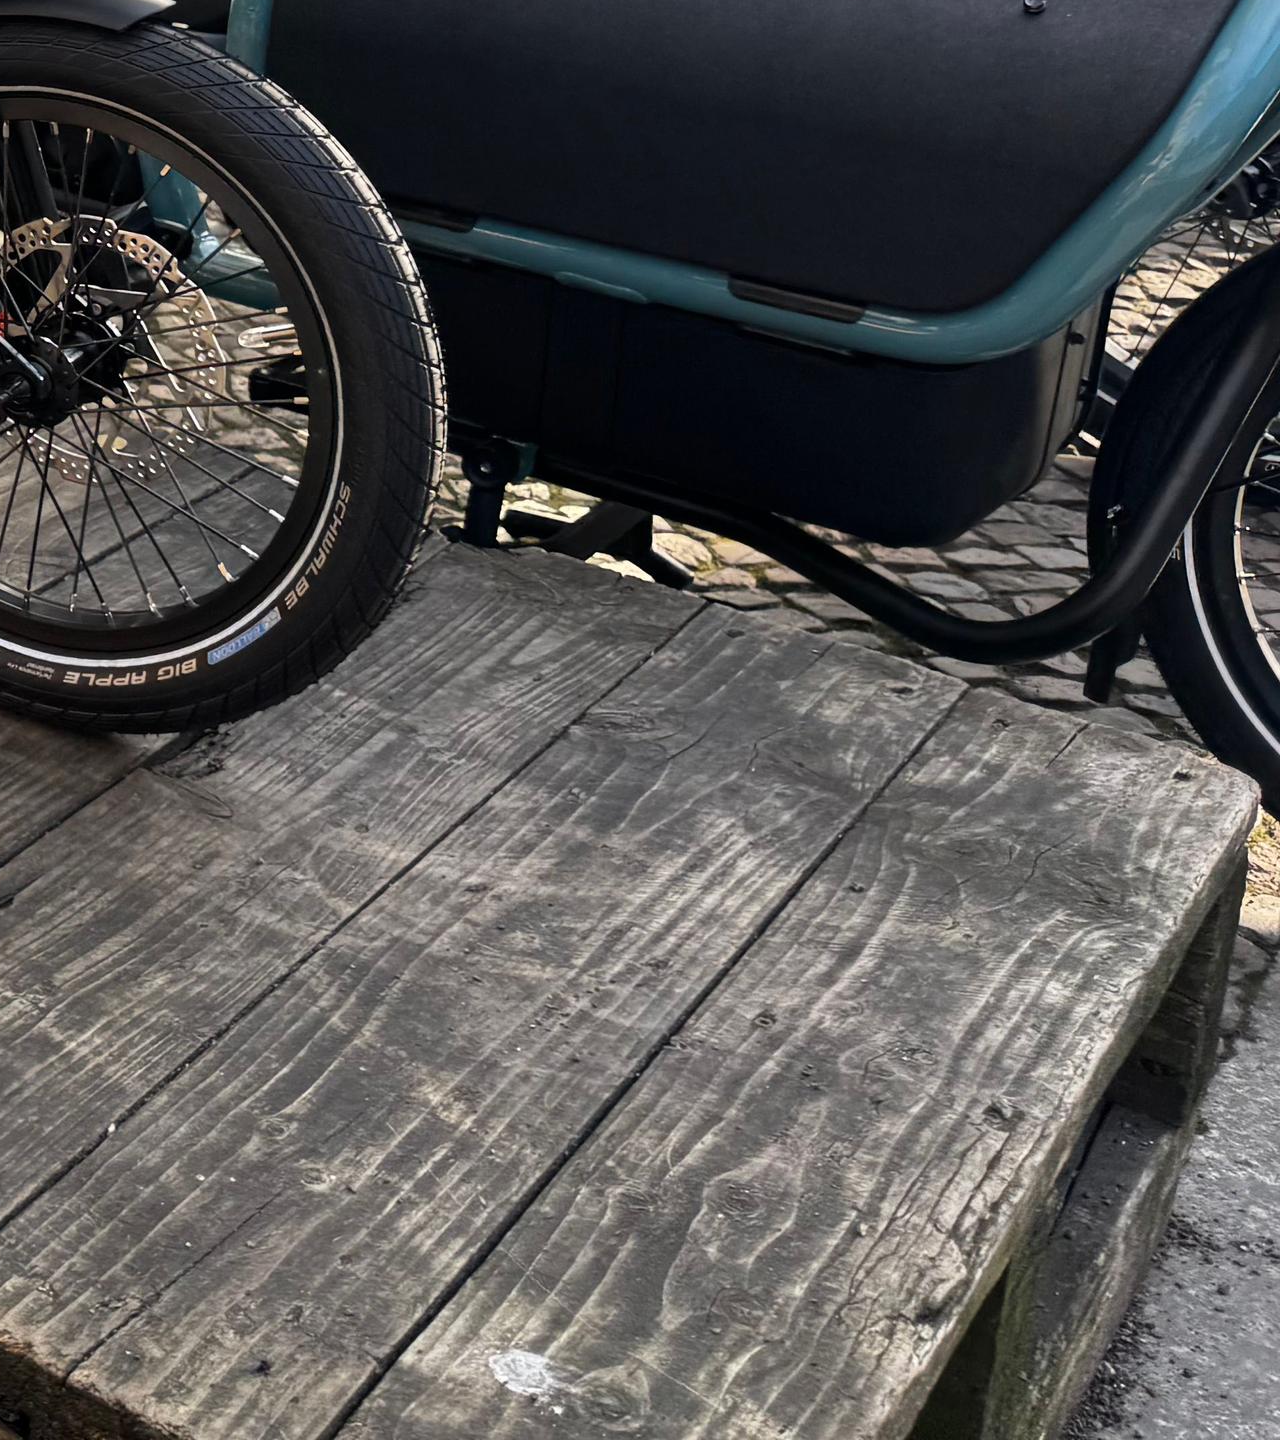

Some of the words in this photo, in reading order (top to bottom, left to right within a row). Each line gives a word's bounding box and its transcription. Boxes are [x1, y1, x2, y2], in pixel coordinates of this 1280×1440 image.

[285, 480, 352, 611] SCHWALBE
[62, 668, 146, 688] APPLE
[156, 657, 198, 683] BIG
